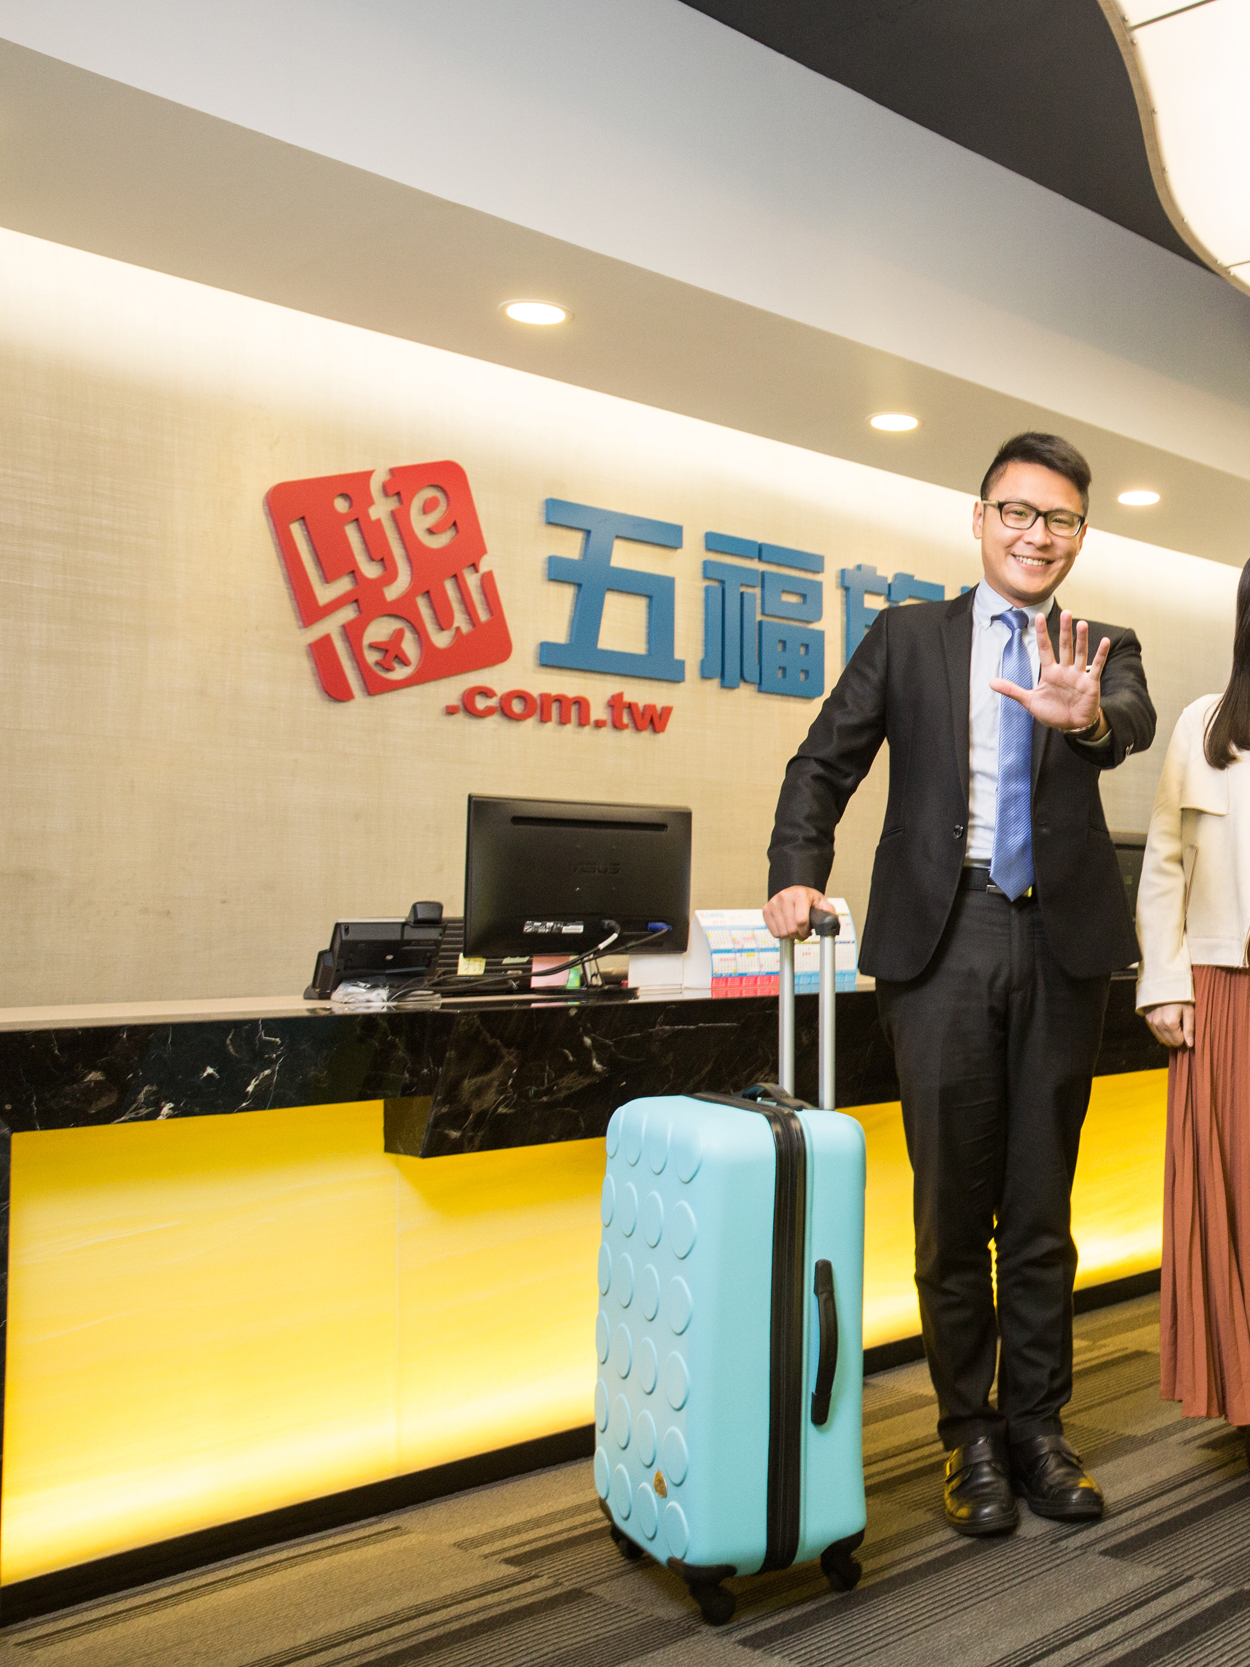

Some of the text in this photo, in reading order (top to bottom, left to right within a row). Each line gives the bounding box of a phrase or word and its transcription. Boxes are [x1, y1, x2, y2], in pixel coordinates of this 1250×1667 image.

[289, 468, 460, 607] Life
[539, 497, 973, 699] 五福
[301, 553, 495, 700] Tour
[445, 685, 674, 733] .com.tw
